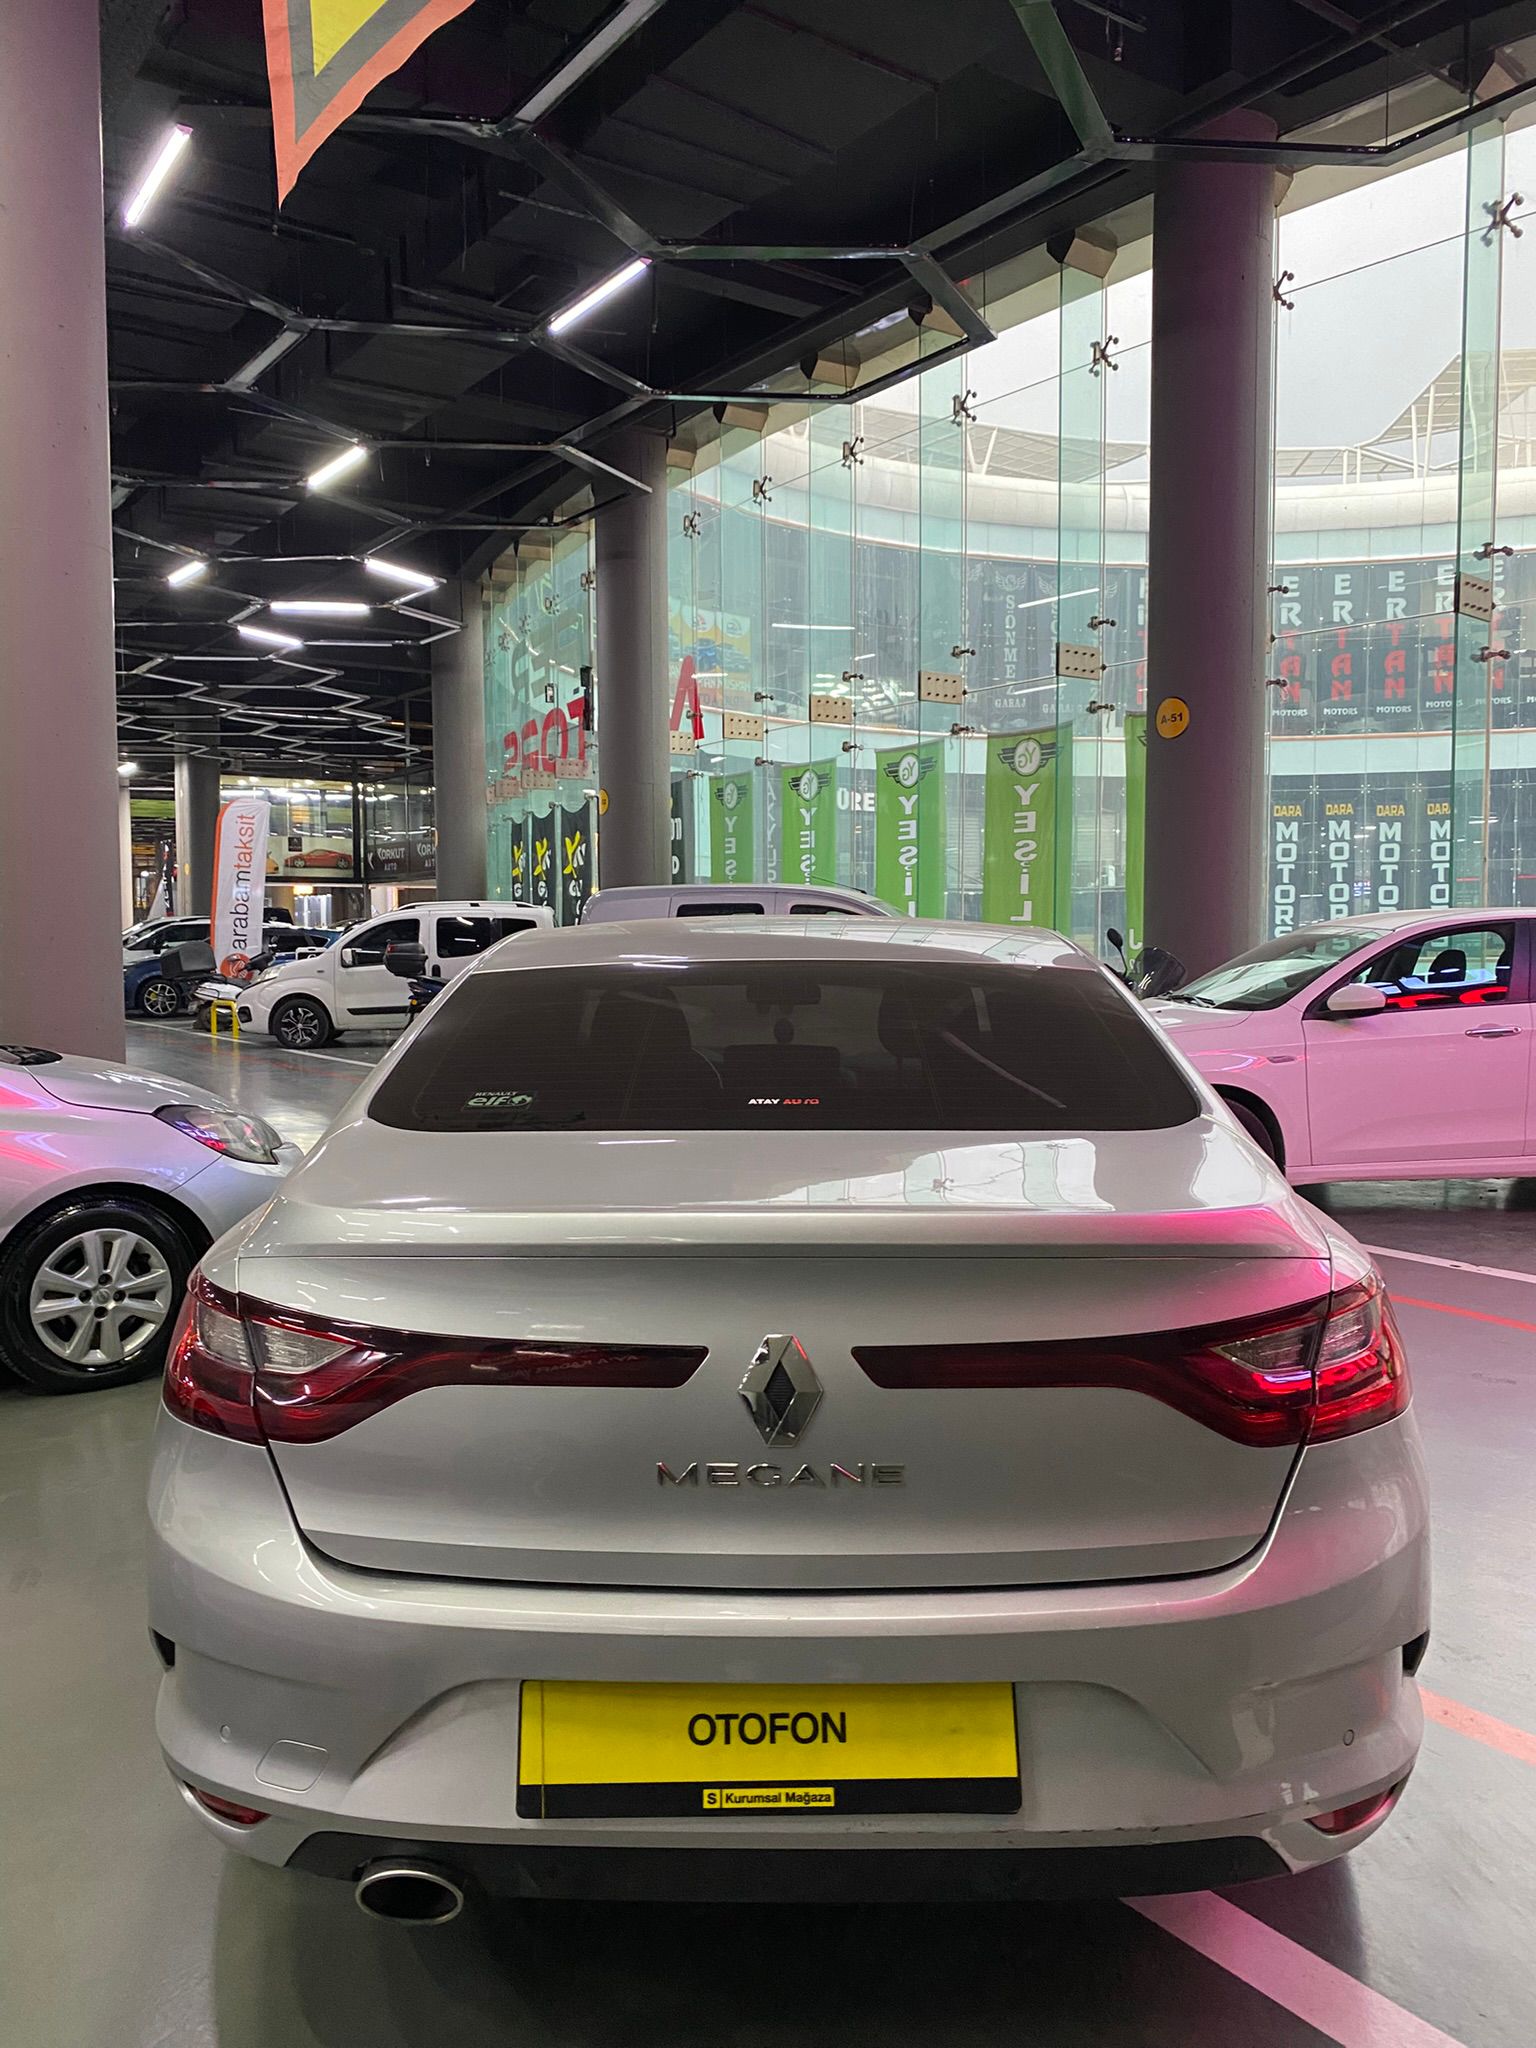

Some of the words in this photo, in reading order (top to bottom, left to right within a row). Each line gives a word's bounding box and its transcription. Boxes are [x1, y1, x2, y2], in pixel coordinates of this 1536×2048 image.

[1272, 708, 1308, 718] MOTORS
[1323, 707, 1358, 717] MOTORS
[1376, 705, 1412, 715] MOTORS
[1160, 712, 1183, 725] A-51
[1273, 805, 1302, 817] DARA
[1325, 804, 1354, 815] DARA
[1376, 805, 1405, 816] DARA
[1427, 803, 1450, 815] DAR
[229, 813, 256, 951] arabamtaksit
[656, 1462, 905, 1488] MEGANE
[688, 1712, 847, 1746] OTOFON
[725, 1792, 782, 1804] Kurumsal
[785, 1790, 832, 1805] Mağaza
